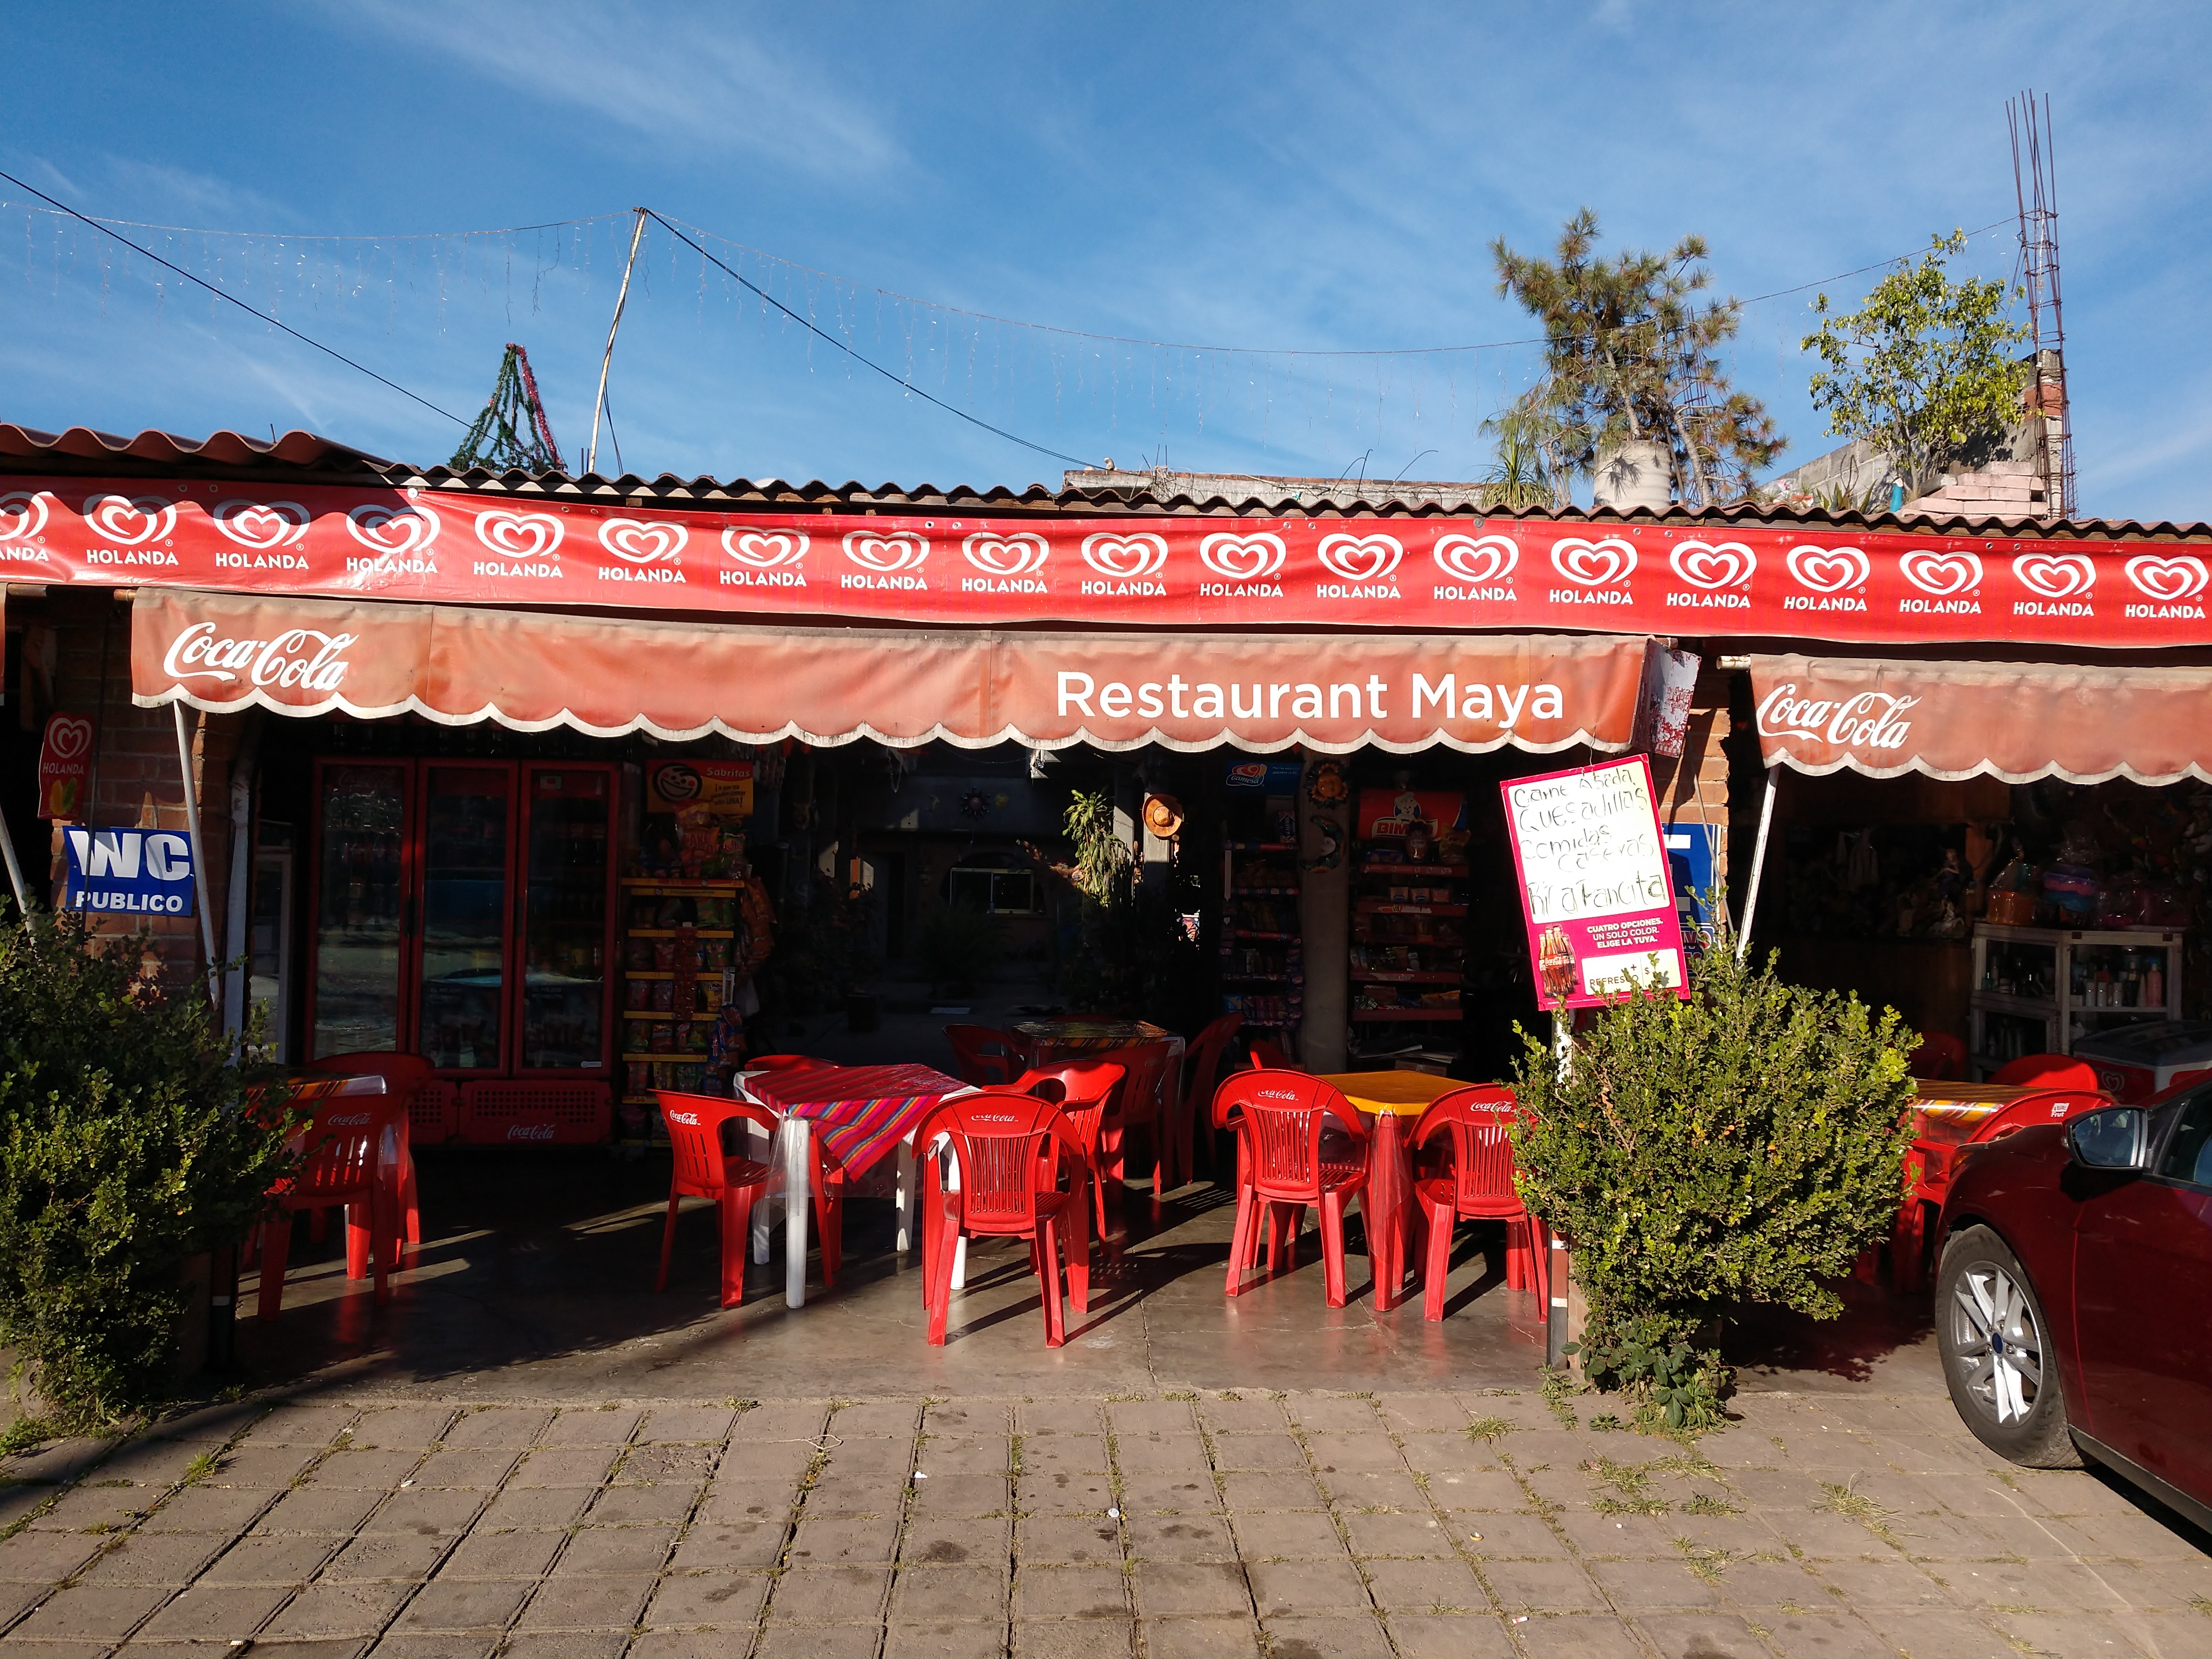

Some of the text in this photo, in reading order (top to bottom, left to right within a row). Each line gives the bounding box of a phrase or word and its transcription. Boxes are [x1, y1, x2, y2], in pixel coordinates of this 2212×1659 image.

[87, 549, 179, 566] HOLANDA
[216, 552, 309, 570] HOLANDA
[346, 557, 438, 574] HOLANDA
[474, 561, 563, 579] HOLANDA
[598, 567, 686, 583] HOLANDA
[720, 571, 807, 587] HOLANDA
[841, 575, 927, 591] HOLANDA
[962, 578, 1047, 593] HOLANDA
[1081, 581, 1166, 596] HOLANDA
[1200, 583, 1284, 598] HOLANDA
[1317, 585, 1401, 599] HOLANDA
[1434, 586, 1517, 601] HOLANDA
[1550, 589, 1633, 605] HOLANDA
[1667, 593, 1750, 608] HOLANDA
[1784, 596, 1867, 612] HOLANDA
[1900, 599, 1981, 614] HOLANDA
[2013, 602, 2094, 617] HOLANDA
[2126, 604, 2205, 618] HOLANDA
[163, 622, 359, 691] Coca-Cola
[1058, 671, 1563, 729] Restaurant Maya
[1756, 684, 1922, 749] Coca-Cola
[43, 762, 84, 774] HOLANDA
[707, 767, 750, 778] Sabritas
[1230, 775, 1259, 784] Gamesa
[1514, 784, 1569, 808] Carne
[68, 830, 191, 881] WC
[75, 890, 183, 912] PUBLICO
[1587, 917, 1663, 933] CUATRO OPCIONES.
[1606, 930, 1629, 940] SOLO
[1630, 926, 1660, 937] COLOR.
[1597, 935, 1658, 948] ELIGE LA TUYA.
[1589, 974, 1639, 986] REFRESO
[1470, 1100, 1514, 1113] Coca-Cola
[328, 1113, 373, 1126] Coca-Cola
[670, 1109, 698, 1125] Coca-Cola
[971, 1113, 1015, 1122] CocaCola
[507, 1124, 556, 1140] Coca-Cola
